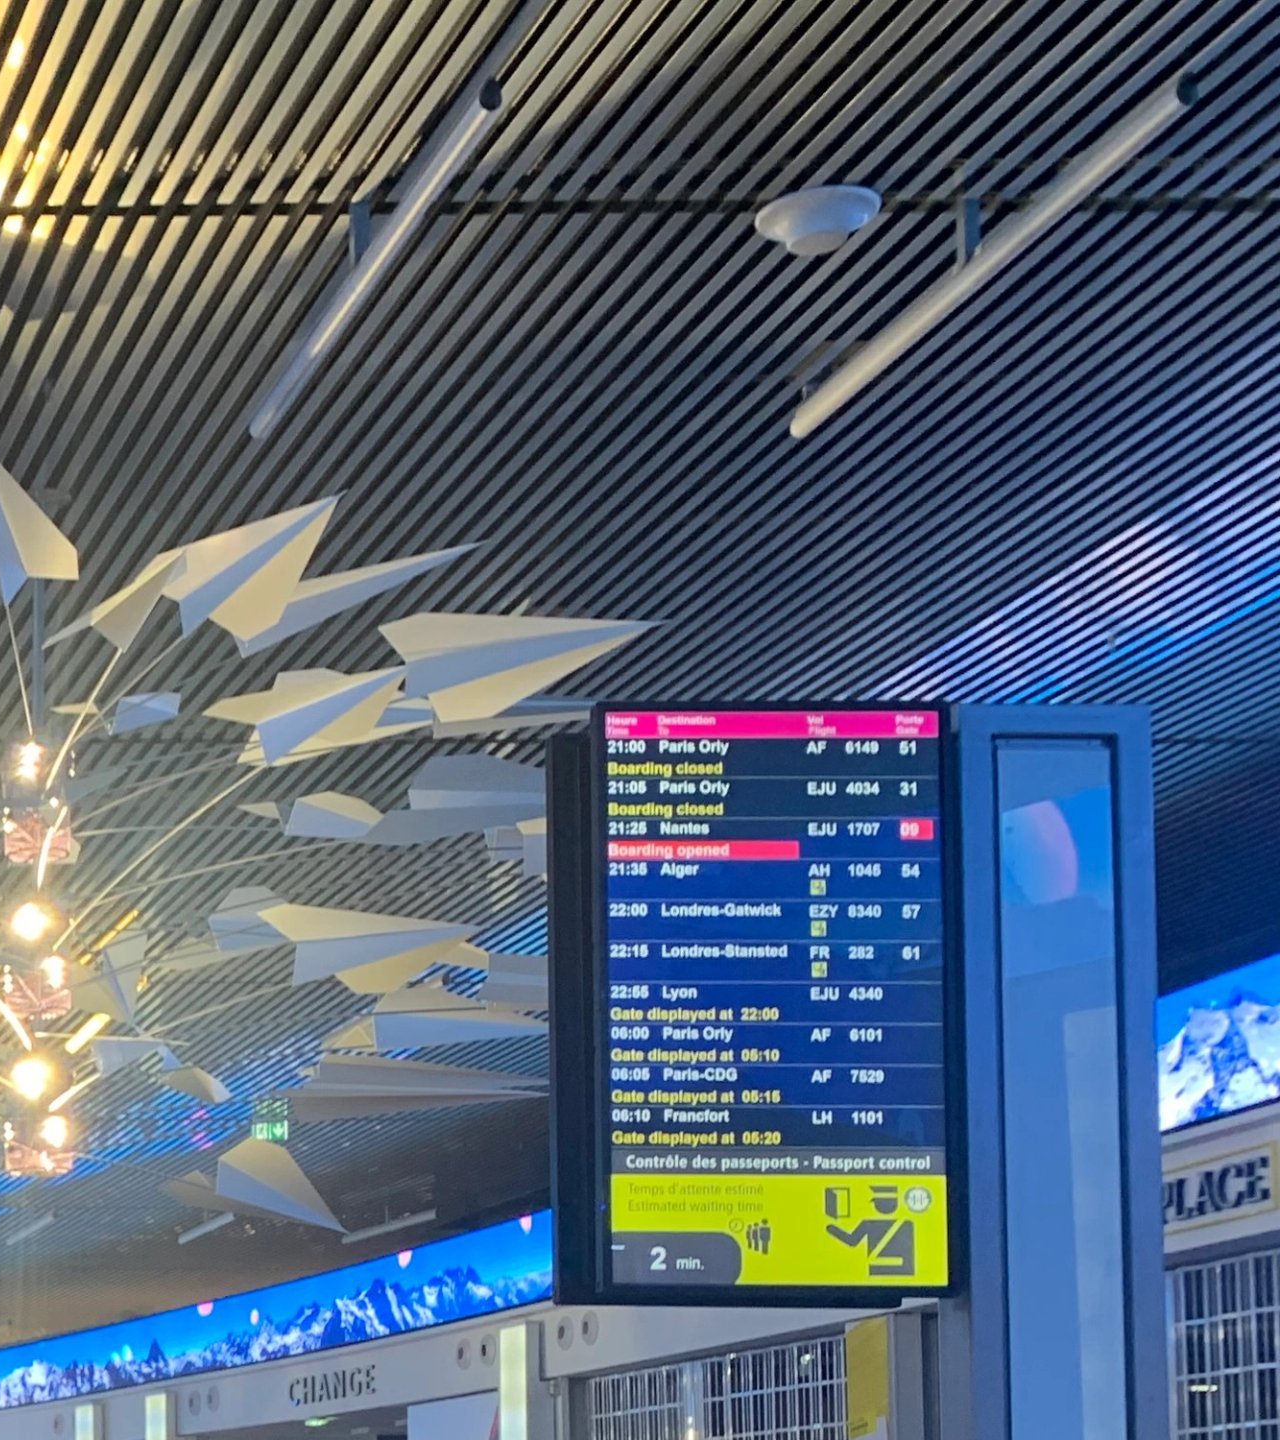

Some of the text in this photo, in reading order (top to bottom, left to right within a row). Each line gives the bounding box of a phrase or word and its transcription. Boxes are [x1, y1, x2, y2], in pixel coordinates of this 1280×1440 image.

[657, 715, 716, 725] Destination
[607, 740, 917, 756] 21:00 Paris Orly AF 6149 51
[607, 761, 723, 777] Boarding closed
[608, 780, 917, 797] 21:05 Paris Orly EJU 4034 31
[608, 802, 724, 818] Boarding closed
[608, 821, 920, 836] 21:25 Nantes EJU 1707 09
[608, 843, 730, 859] Boarding opened
[609, 862, 920, 879] 21:35 Alger AH 1045 54
[609, 903, 921, 919] 22:00 Londres-Gatwick EZY 8340 57
[610, 943, 920, 960] 22:15 Londres-Stansted FR 282 61
[662, 985, 698, 1002] Lyon
[810, 986, 839, 1001] EJU
[848, 986, 883, 1001] 4340
[610, 1007, 779, 1023] Gate displayed at 22:00
[611, 1026, 882, 1043] 06:00 Paris Orly AF 6101
[611, 1048, 780, 1064] Gate displayed at 05:10
[611, 1067, 650, 1081] 06:05
[663, 1067, 738, 1081] Paris-CDG
[811, 1069, 831, 1083] AF
[611, 1089, 644, 1103] Gate
[648, 1089, 717, 1105] displayed
[720, 1090, 734, 1103] at
[612, 1109, 883, 1125] 06:10 Francfort LH 1101
[612, 1130, 645, 1144] Gate
[648, 1130, 717, 1147] displayed
[721, 1131, 735, 1145] at
[626, 1154, 687, 1168] Contrôle
[692, 1155, 717, 1169] des
[721, 1156, 799, 1171] passeports
[813, 1156, 875, 1172] Passport
[879, 1156, 931, 1170] control
[628, 1182, 764, 1197] Temps d'attente estimé
[628, 1200, 764, 1215] Estimated waiting time
[649, 1246, 705, 1271] 2 min.
[288, 1364, 376, 1407] CHANGE
